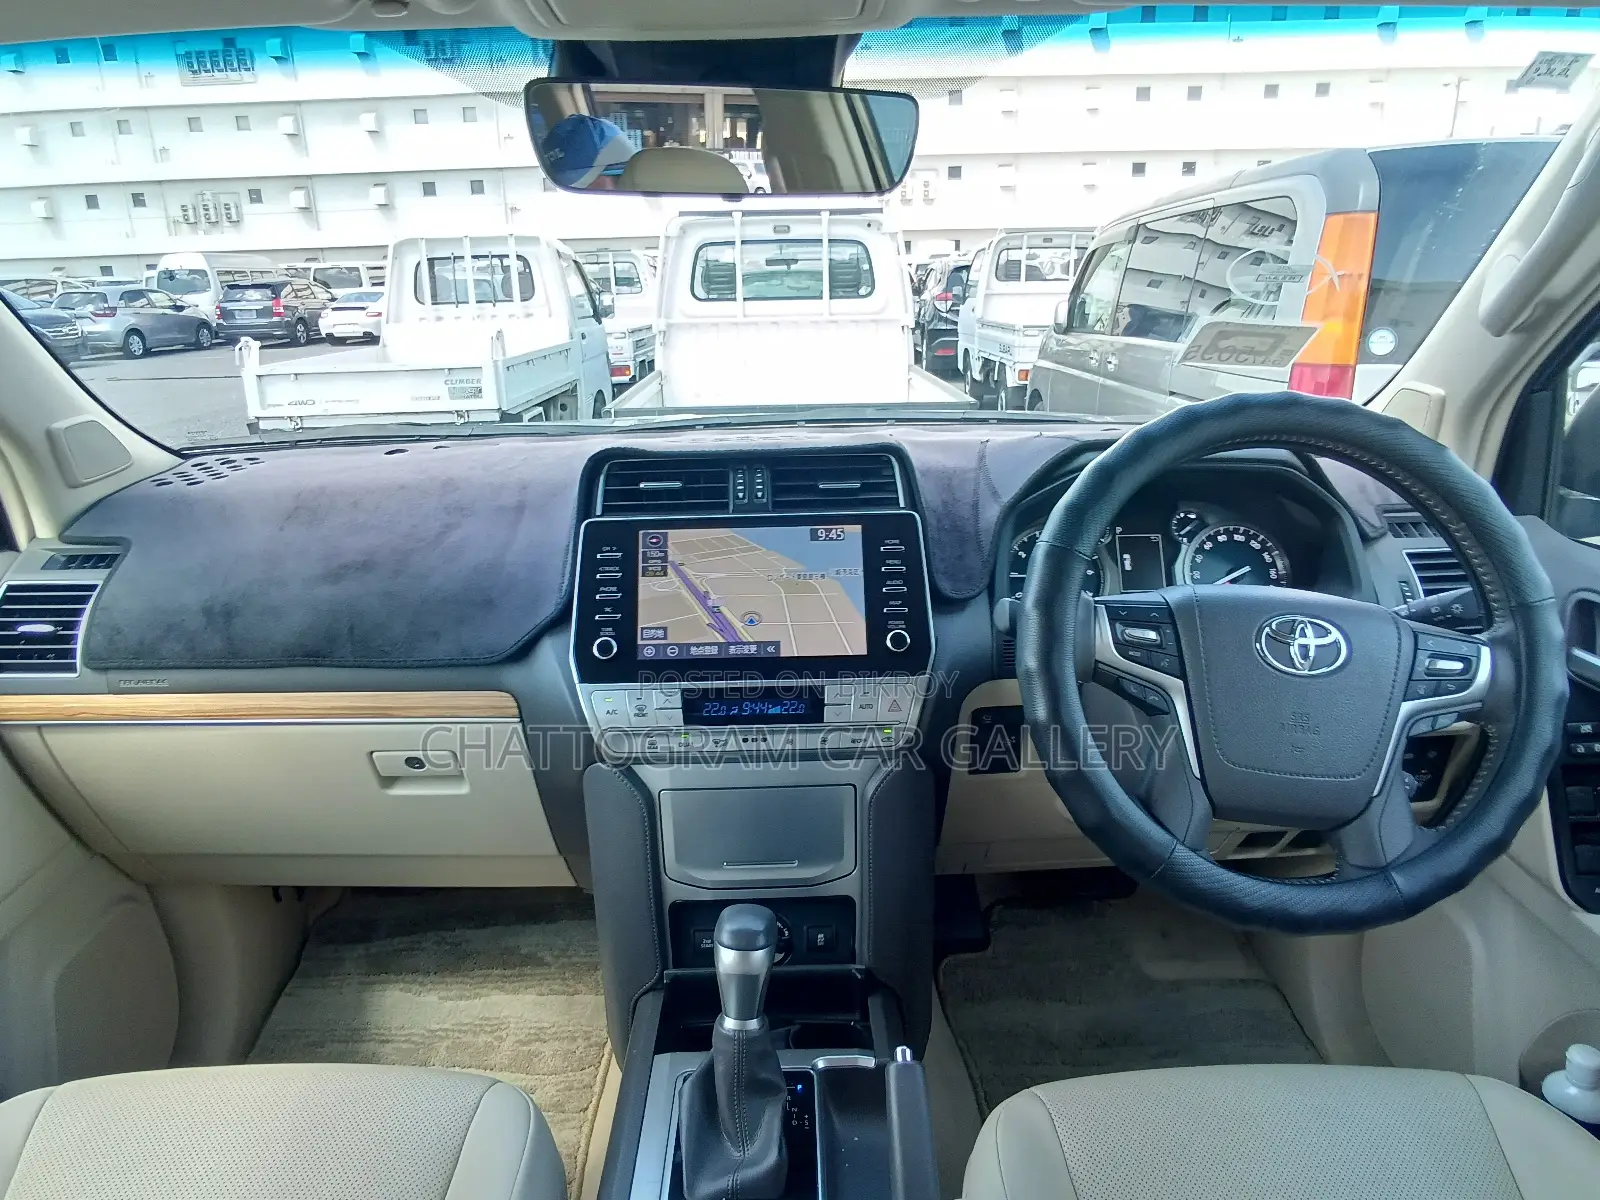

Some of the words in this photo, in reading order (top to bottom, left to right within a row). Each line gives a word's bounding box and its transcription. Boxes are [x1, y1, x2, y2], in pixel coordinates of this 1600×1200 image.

[444, 378, 482, 386] CLIMBER
[817, 528, 844, 541] 9:45
[1115, 526, 1123, 534] P
[1203, 541, 1214, 550] 60
[1194, 554, 1204, 564] 40
[1193, 570, 1201, 580] 20
[1269, 568, 1278, 579] 160
